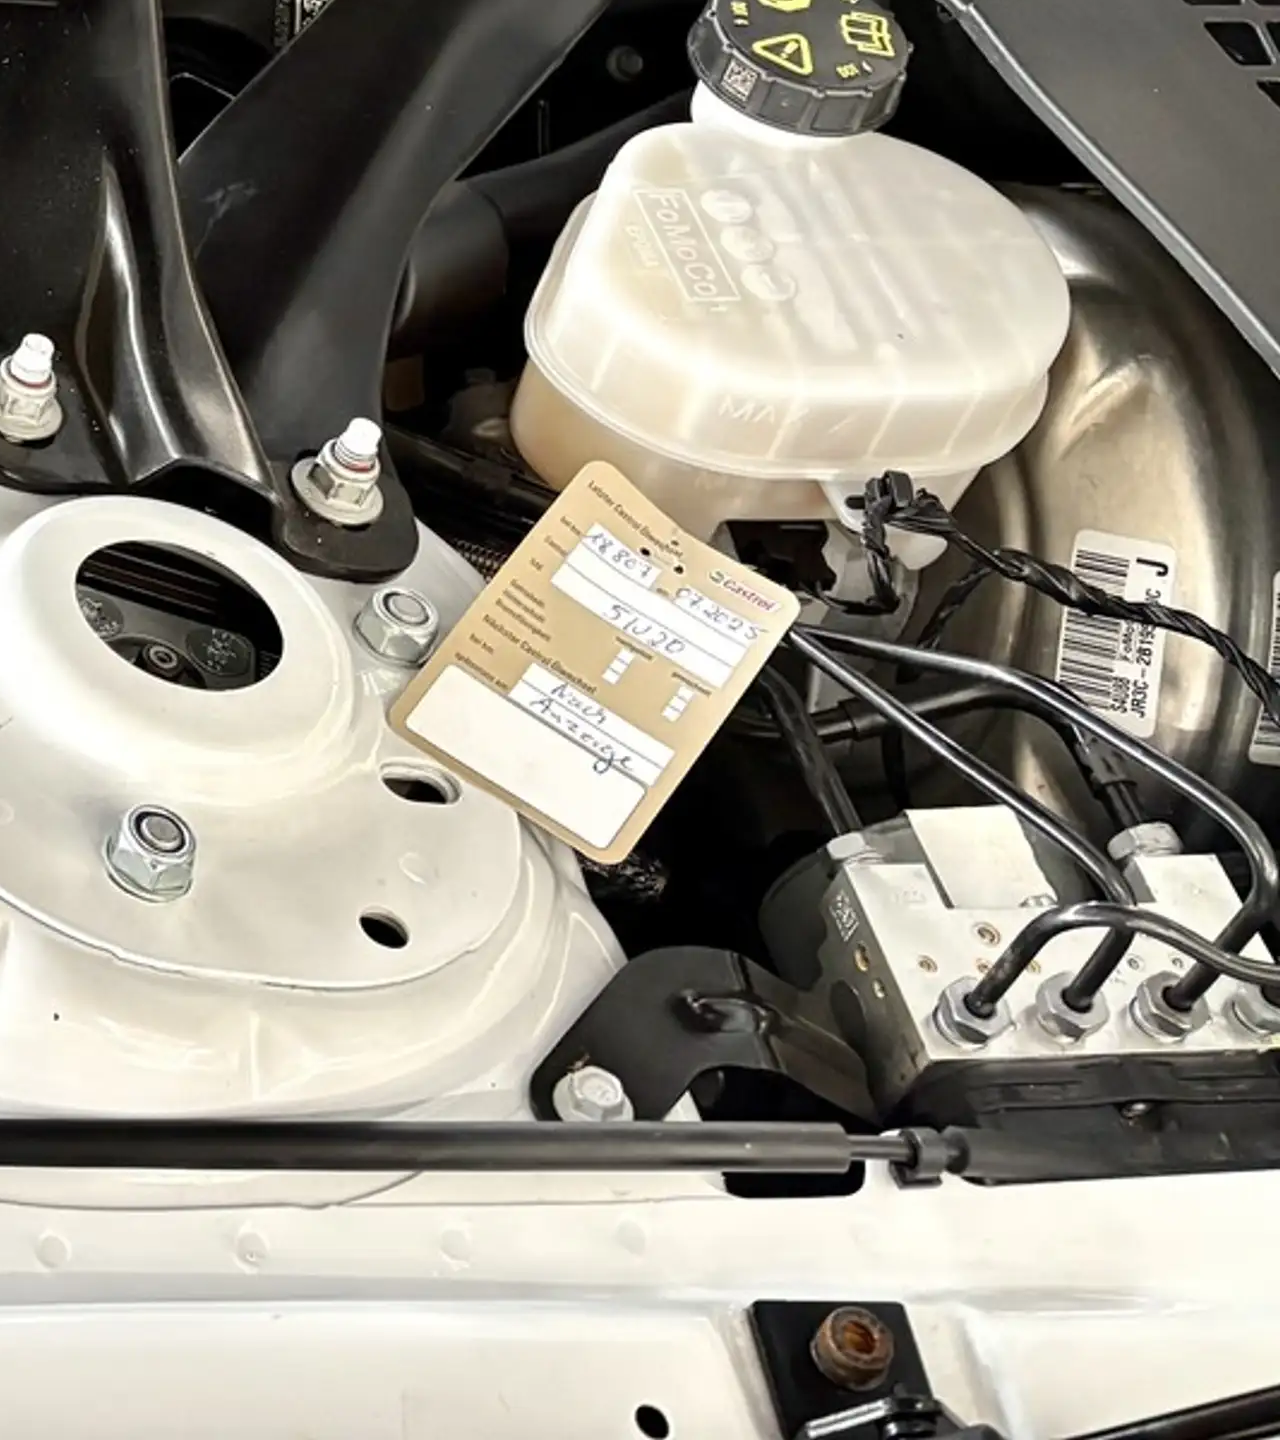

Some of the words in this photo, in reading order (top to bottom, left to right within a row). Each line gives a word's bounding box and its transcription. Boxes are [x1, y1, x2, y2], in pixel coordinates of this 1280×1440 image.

[647, 194, 718, 296] FoMoCo
[1136, 556, 1169, 578] J
[721, 577, 776, 611] Castrol
